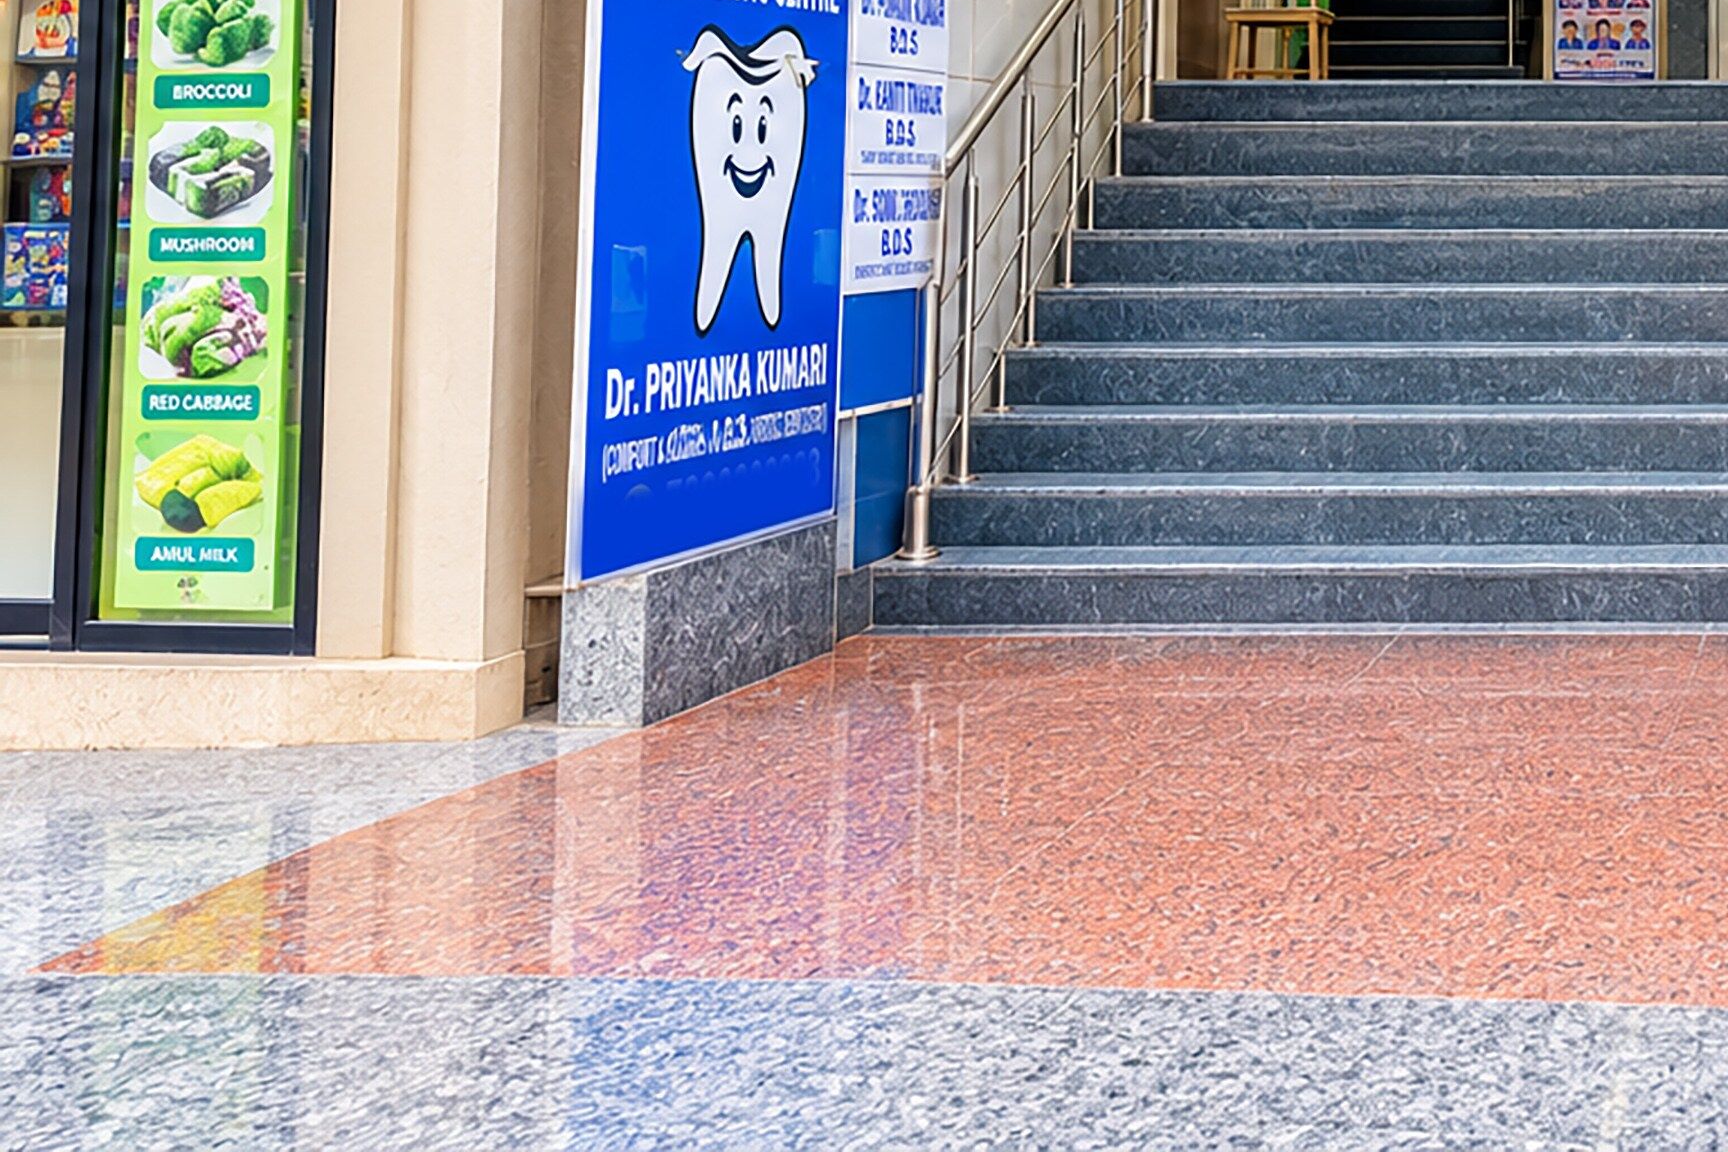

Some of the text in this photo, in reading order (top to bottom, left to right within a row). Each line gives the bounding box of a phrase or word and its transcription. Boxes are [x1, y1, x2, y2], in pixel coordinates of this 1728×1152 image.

[149, 395, 179, 411] RED
[605, 342, 828, 420] Dr. PRIYANKA KUMARI
